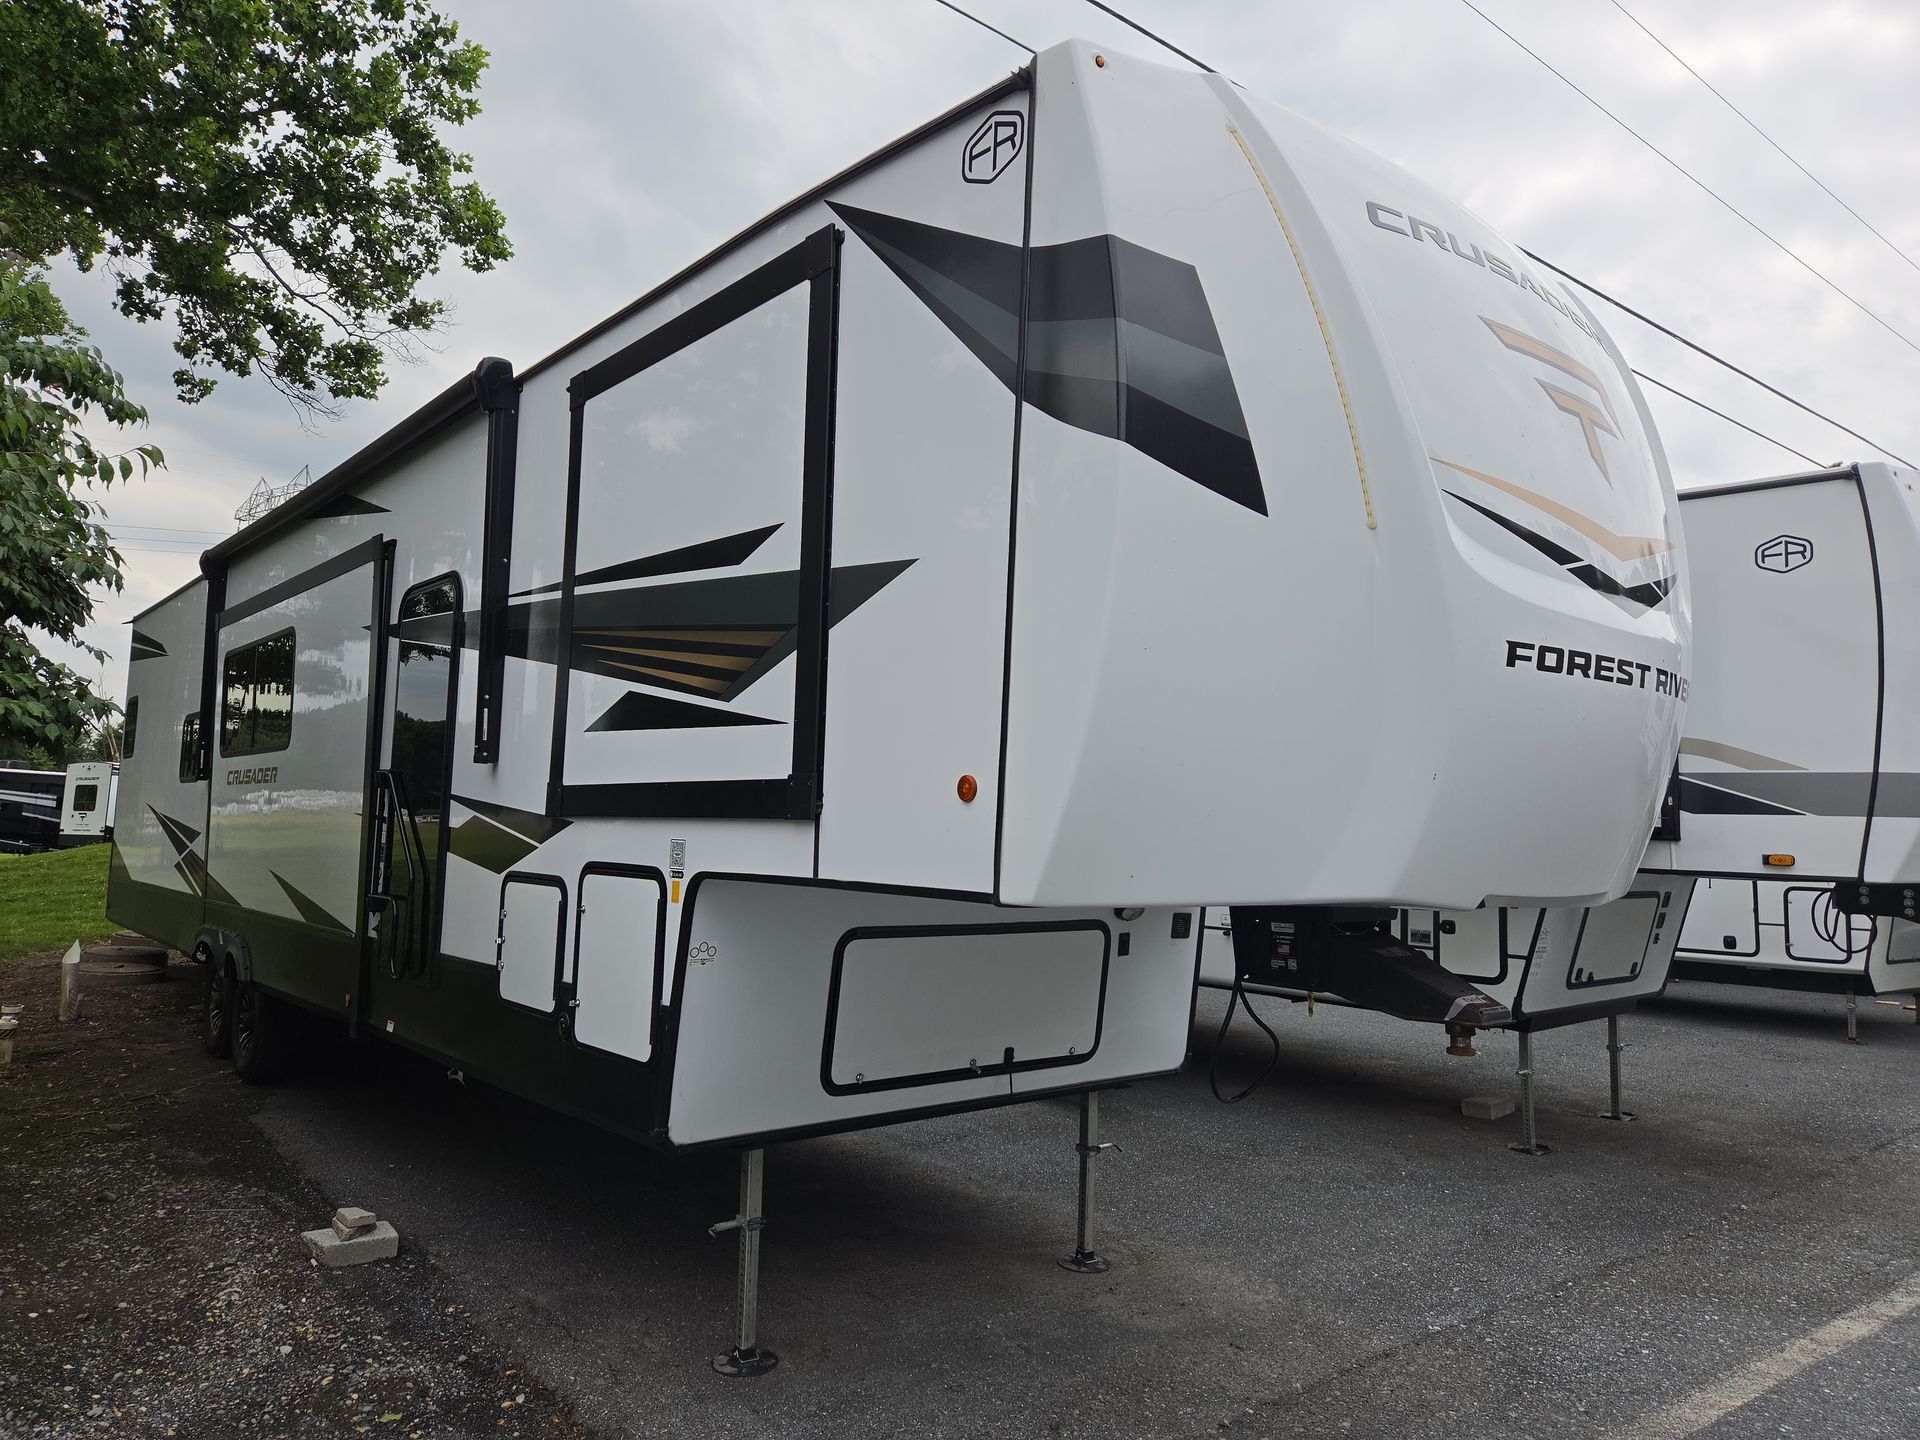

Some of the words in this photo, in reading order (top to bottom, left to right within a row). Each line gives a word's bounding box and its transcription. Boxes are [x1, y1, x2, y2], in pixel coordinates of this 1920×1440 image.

[1505, 639, 1652, 689] FOREST
[1655, 667, 1690, 702] RIVE
[226, 766, 279, 785] CRUSADER
